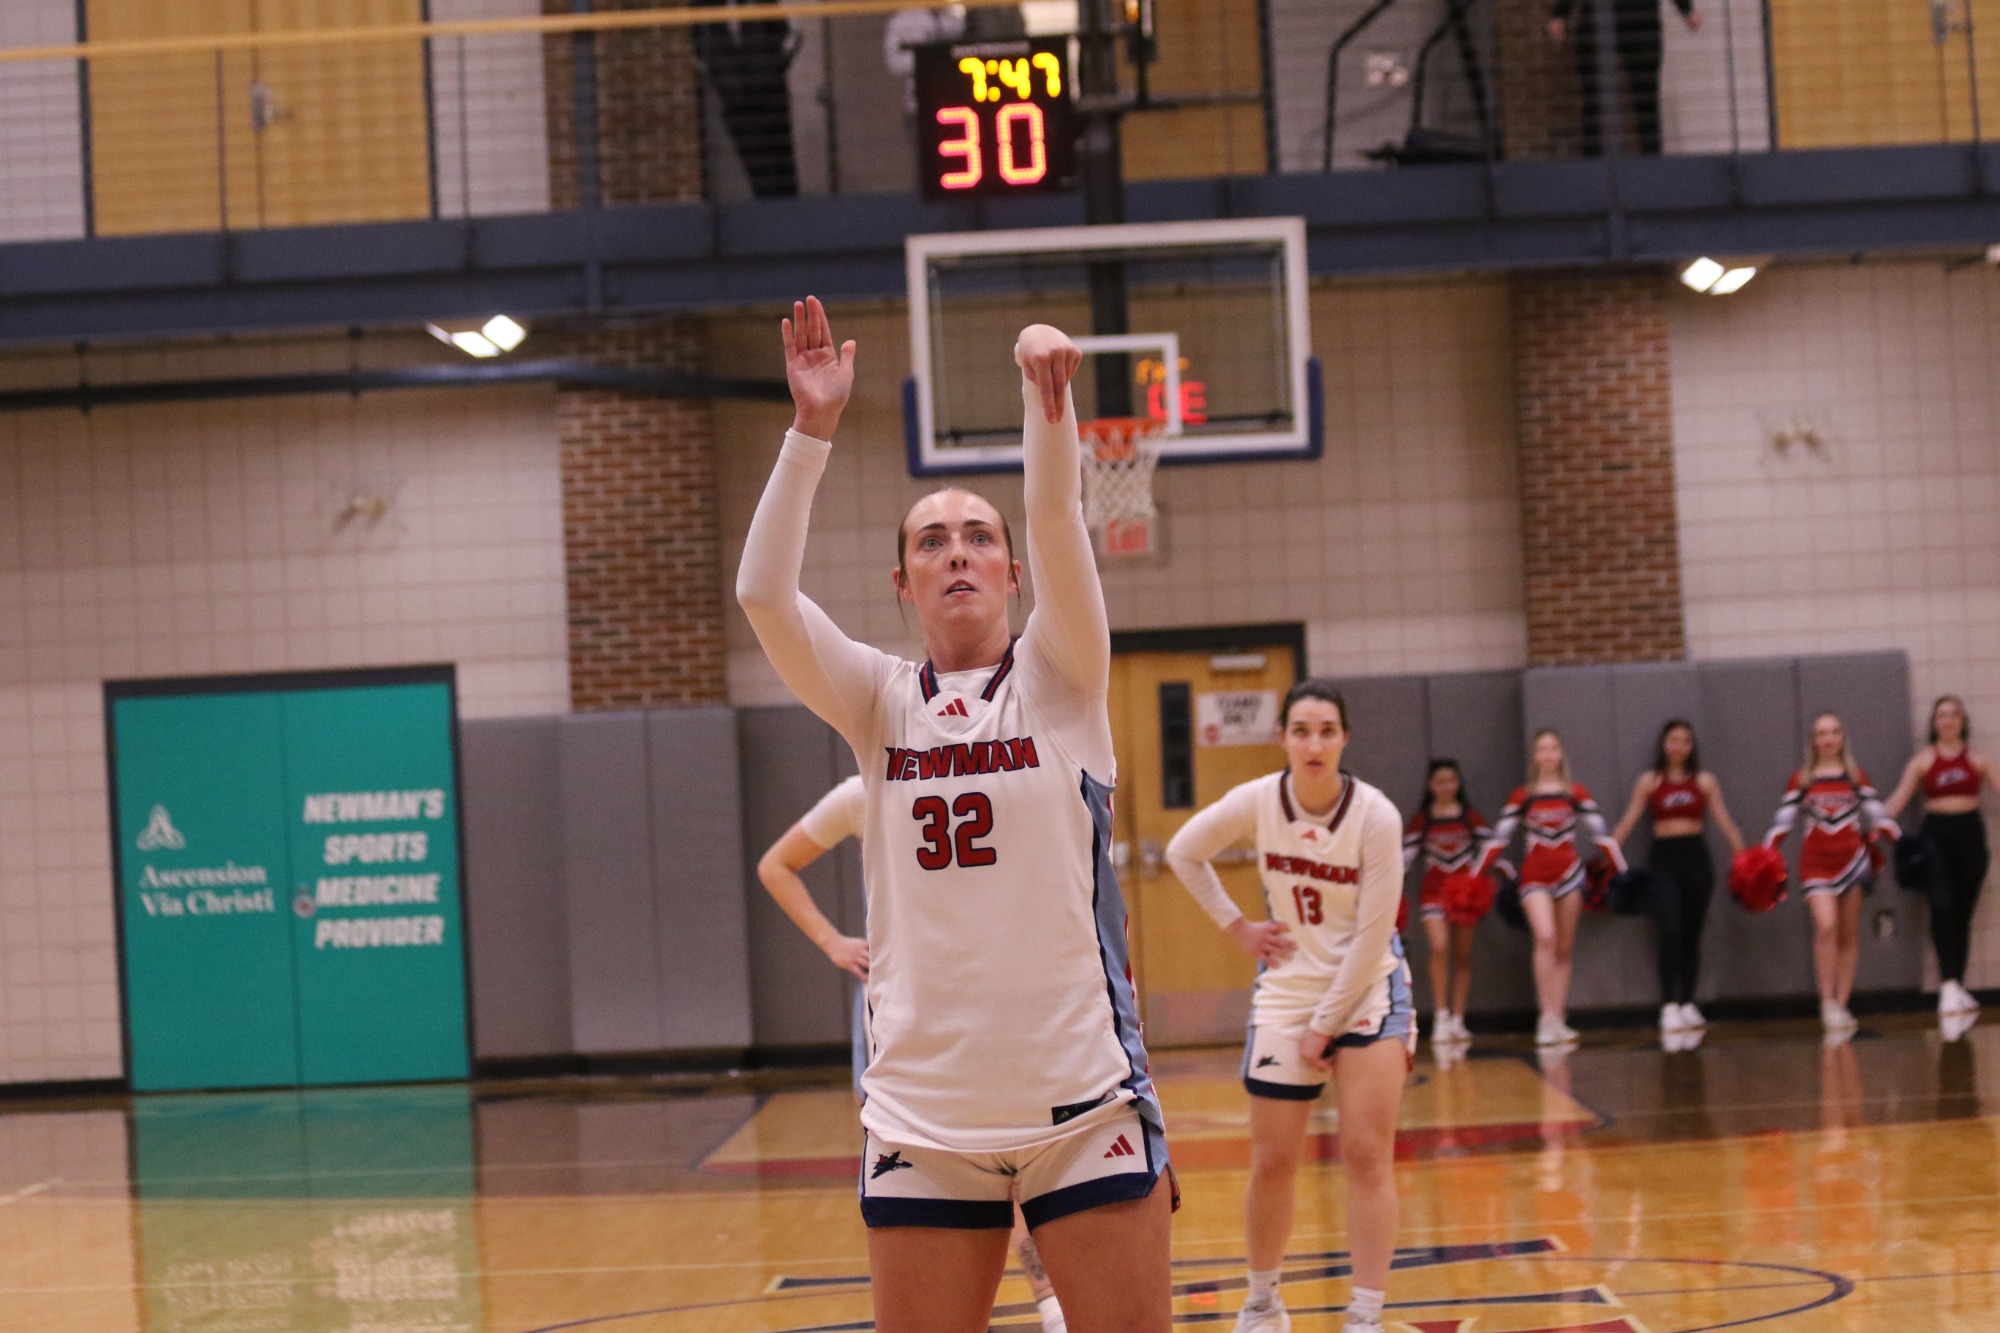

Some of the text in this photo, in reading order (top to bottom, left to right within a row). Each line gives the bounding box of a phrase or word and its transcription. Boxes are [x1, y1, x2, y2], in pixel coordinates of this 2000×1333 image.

[959, 52, 1061, 102] 7:47
[936, 103, 1047, 189] 30
[885, 736, 1040, 780] NEWMAN
[303, 788, 445, 824] NEWMAN'S
[323, 831, 428, 865] SPORTS
[912, 791, 997, 871] 32
[139, 861, 267, 888] Ascension
[1265, 852, 1360, 885] NEWMAN
[141, 887, 274, 917] Via Christi
[315, 873, 441, 907] MEDICINE
[1292, 885, 1324, 925] 13
[314, 915, 445, 949] PROVIDER
